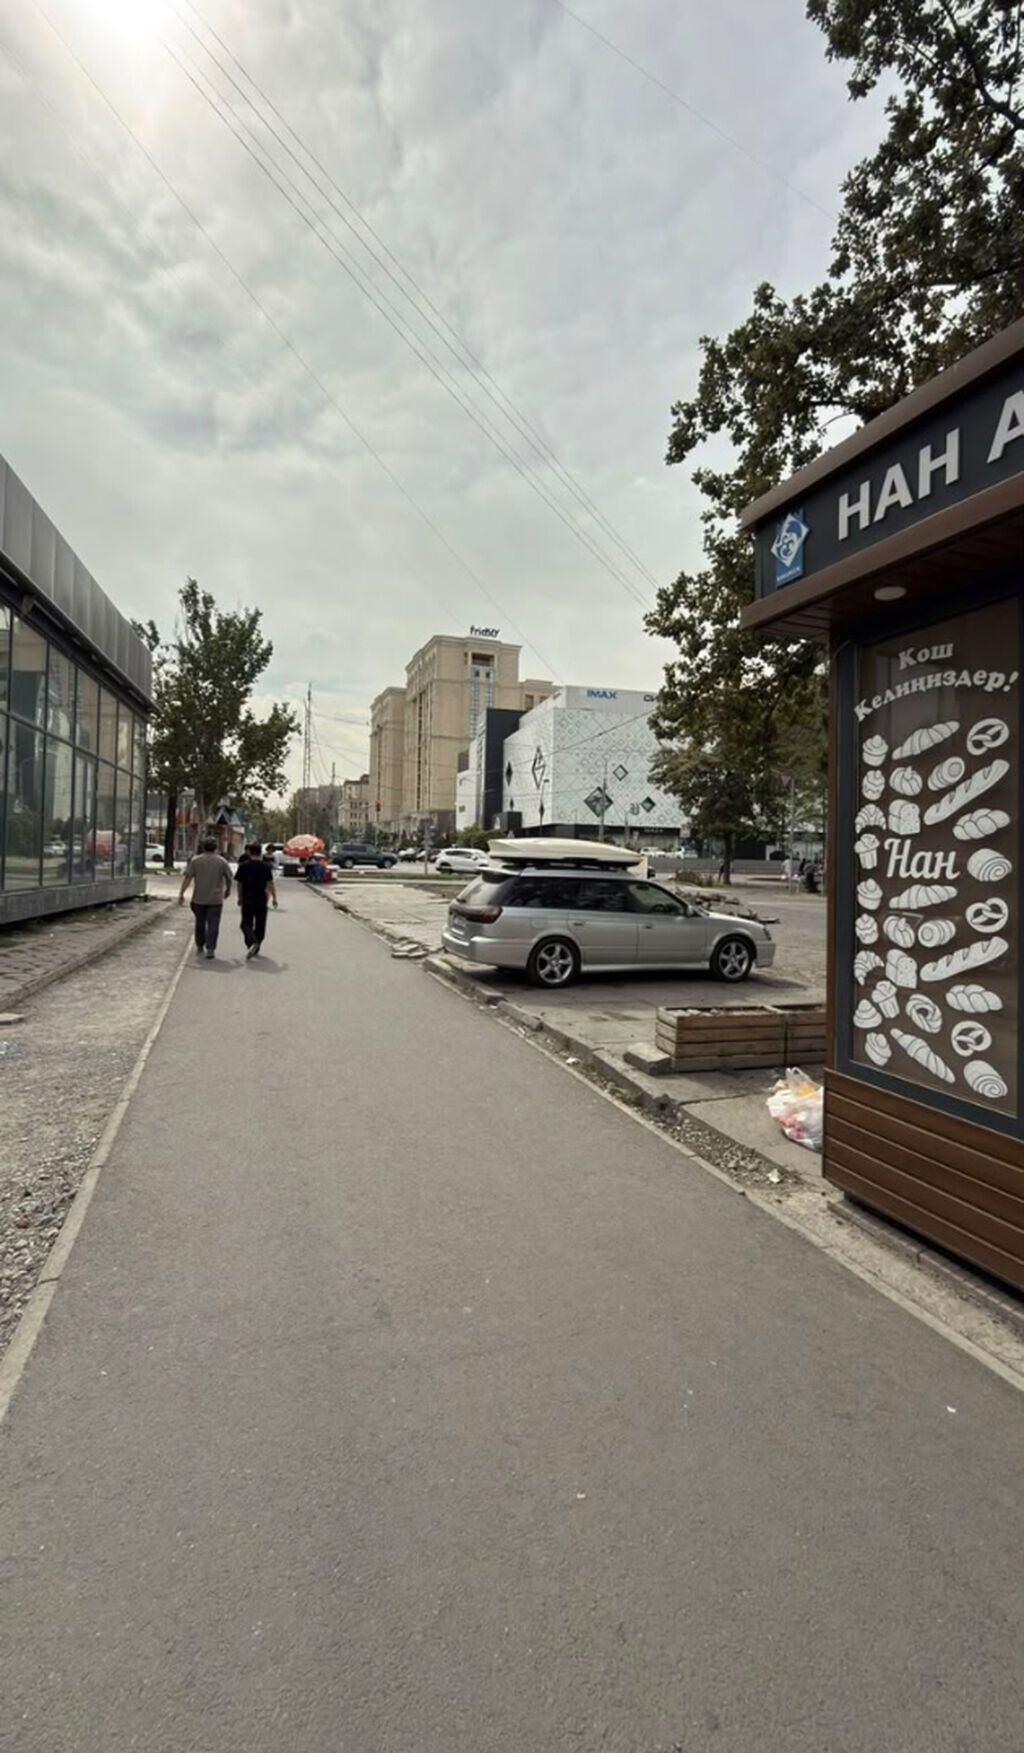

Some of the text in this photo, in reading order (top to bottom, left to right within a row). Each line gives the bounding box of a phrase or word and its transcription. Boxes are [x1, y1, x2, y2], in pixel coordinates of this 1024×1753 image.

[838, 427, 960, 541] НАН
[898, 643, 954, 670] Кош
[586, 690, 617, 699] IMAX
[884, 838, 960, 879] Нан
